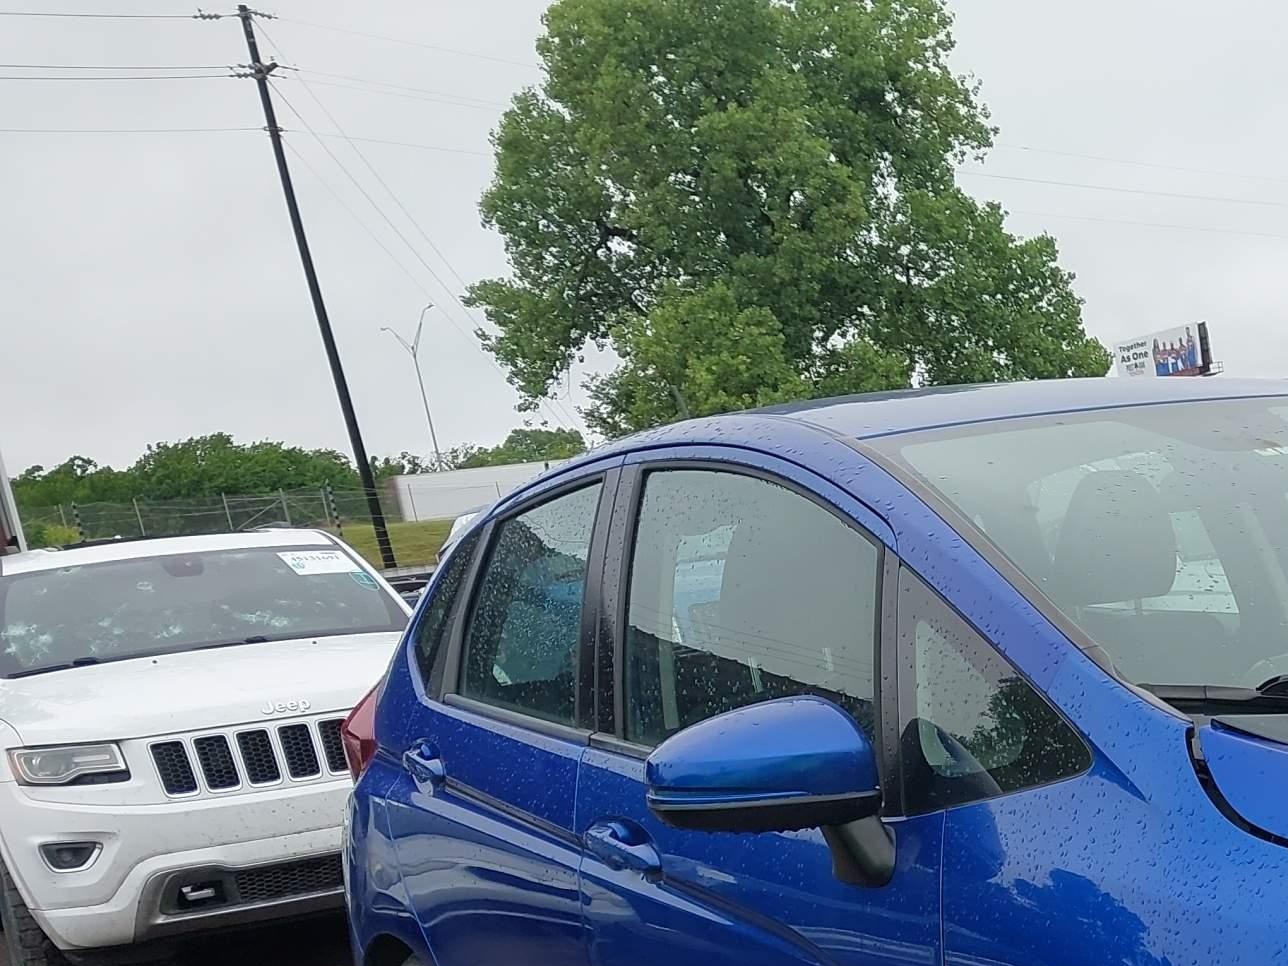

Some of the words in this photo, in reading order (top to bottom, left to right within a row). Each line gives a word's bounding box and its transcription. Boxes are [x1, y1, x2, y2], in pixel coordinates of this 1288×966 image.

[1119, 341, 1147, 353] Together
[1121, 354, 1131, 363] As
[1132, 350, 1149, 361] One
[262, 699, 311, 714] Jeep
